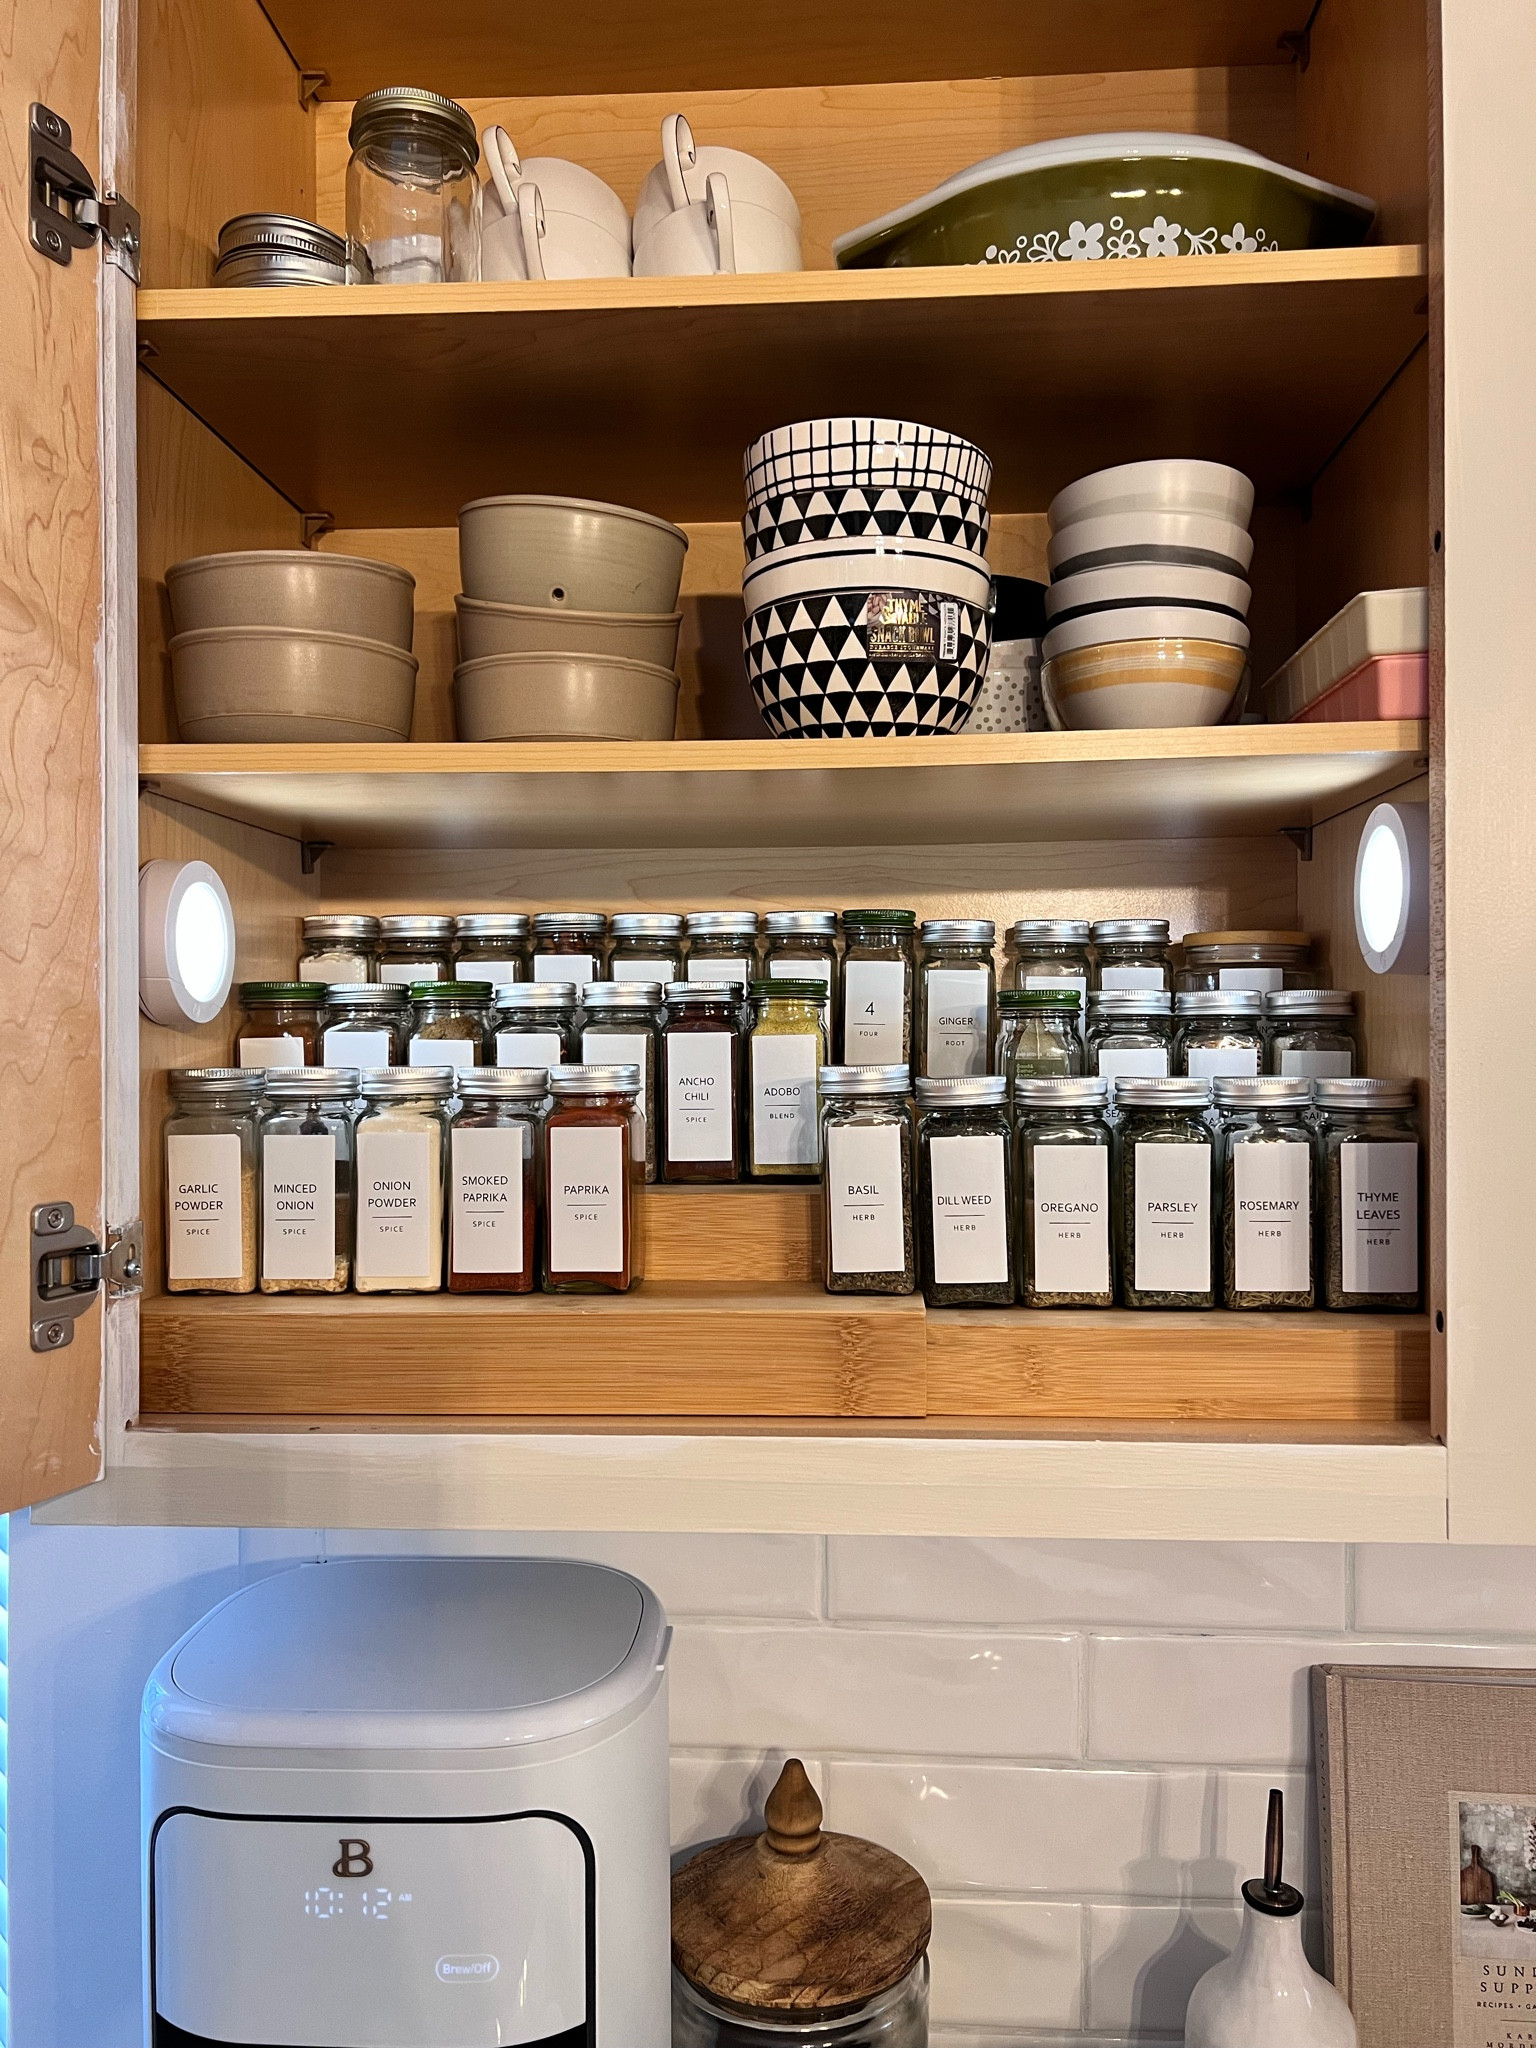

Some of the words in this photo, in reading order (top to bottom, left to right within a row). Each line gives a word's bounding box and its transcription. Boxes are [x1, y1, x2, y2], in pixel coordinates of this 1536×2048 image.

[870, 626, 907, 643] SNACK
[864, 1001, 875, 1016] 4
[938, 1017, 974, 1026] GINGER
[678, 1077, 715, 1086] ANCHO
[684, 1092, 709, 1101] CHILI
[763, 1087, 801, 1097] ADOBO
[769, 1112, 796, 1120] BLEND
[461, 1175, 509, 1186] SMOKED
[178, 1183, 219, 1194] GARLIC
[273, 1183, 317, 1194] MINCED
[372, 1181, 411, 1191] ONION
[563, 1185, 610, 1195] PAPRIKA
[847, 1184, 880, 1195] BASIL
[463, 1192, 508, 1203] PAPRIKA
[936, 1195, 960, 1206] DILL
[960, 1194, 992, 1205] WEED
[1356, 1192, 1400, 1202] THYME
[174, 1200, 224, 1211] POWDER
[276, 1200, 314, 1211] ONION
[367, 1197, 417, 1208] POWDER
[1040, 1202, 1099, 1213] OREGANO
[1147, 1202, 1198, 1213] PARSLEY
[1239, 1200, 1300, 1211] ROSEMARY
[574, 1213, 598, 1221] SPICE
[852, 1213, 875, 1221] HERB
[1356, 1209, 1401, 1220] LEAVES
[379, 1225, 404, 1233] SPICE
[472, 1220, 496, 1228] SPICE
[953, 1224, 976, 1232] HERB
[186, 1228, 210, 1236] SPICE
[282, 1228, 306, 1236] SPICE
[1160, 1231, 1184, 1239] HERB
[1258, 1230, 1282, 1238] HERB
[1366, 1238, 1391, 1246] HERB
[441, 1961, 493, 1976] Brew/Off
[1476, 2001, 1514, 2009] RECIPES
